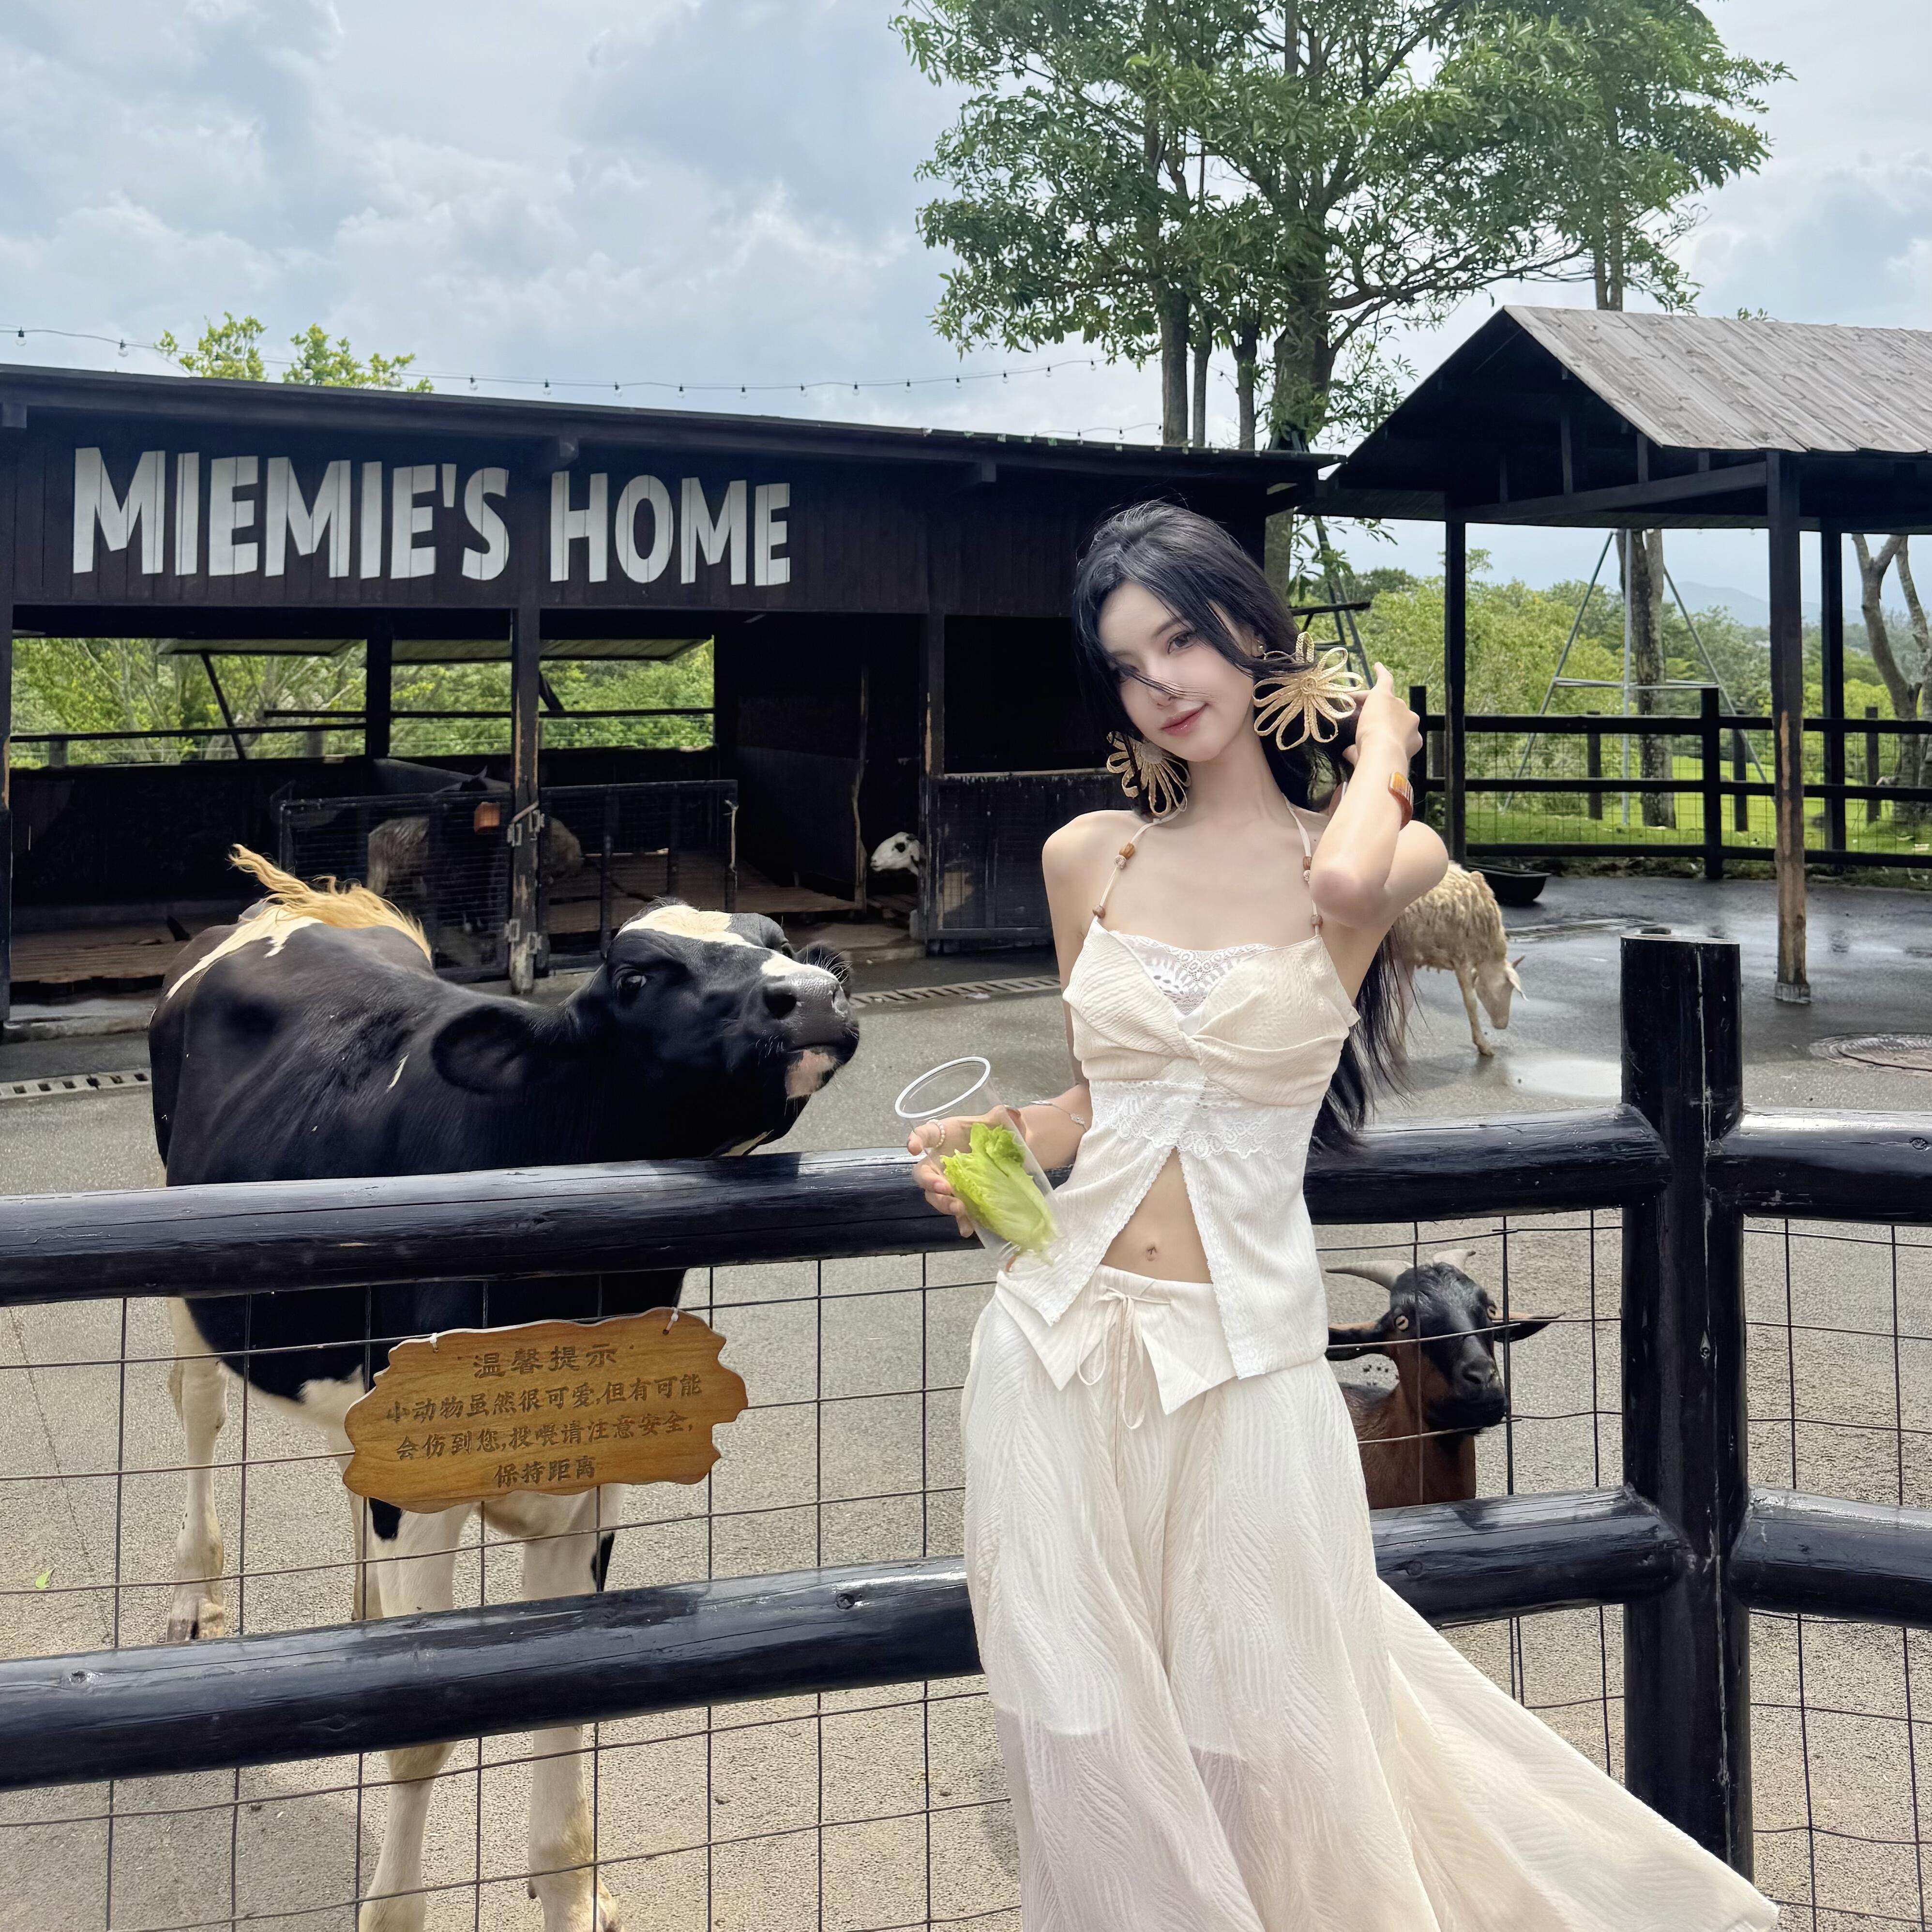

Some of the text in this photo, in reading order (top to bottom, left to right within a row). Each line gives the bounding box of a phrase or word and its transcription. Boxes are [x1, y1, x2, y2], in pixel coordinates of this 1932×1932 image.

[73, 447, 790, 586] MIEMIE'S HOME
[473, 1343, 618, 1378] 温馨提示
[494, 1455, 596, 1488] 保持距离
